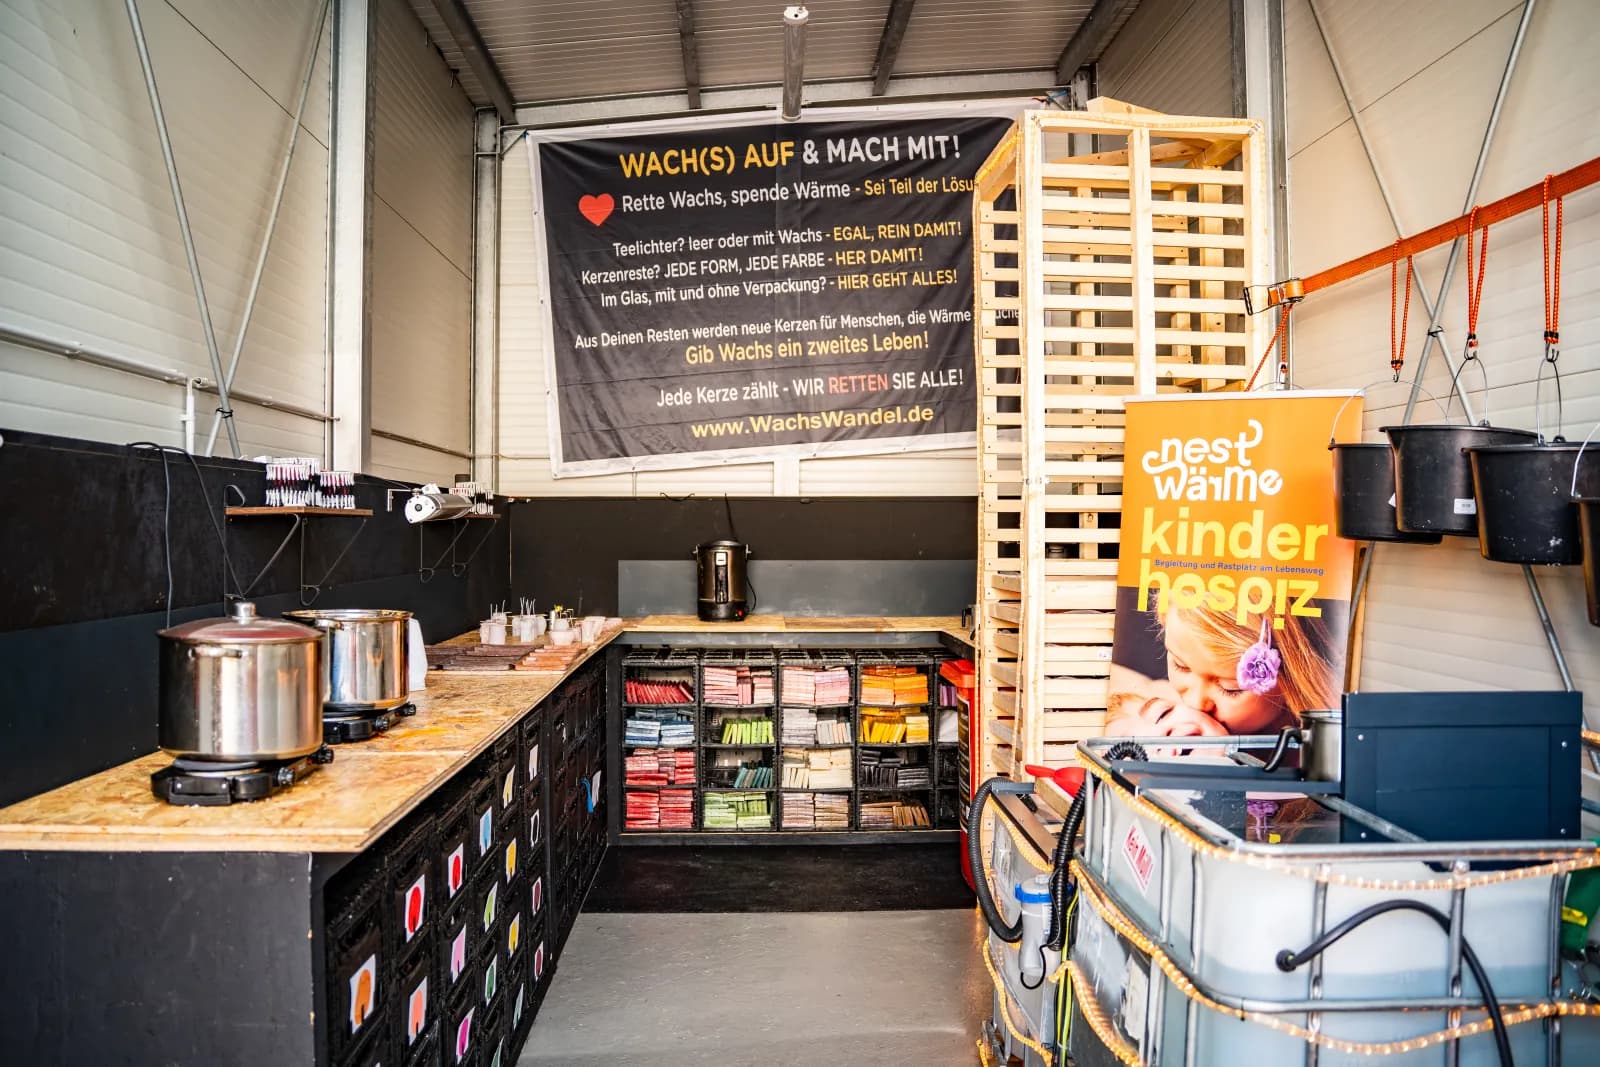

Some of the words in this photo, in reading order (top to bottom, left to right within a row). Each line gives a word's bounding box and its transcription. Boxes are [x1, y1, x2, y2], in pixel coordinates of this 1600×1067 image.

[620, 146, 735, 178] WACH(S)
[744, 142, 794, 168] AUF
[803, 140, 819, 164] &
[827, 137, 899, 163] MACH
[908, 135, 960, 160] MIT!
[623, 194, 664, 212] Rette
[670, 189, 726, 208] Wachs,
[732, 183, 789, 206] spende
[794, 182, 850, 199] Wärme
[865, 179, 885, 195] Sei
[889, 178, 912, 194] Teil
[916, 177, 938, 193] der
[942, 177, 973, 192] Lösu
[613, 238, 684, 256] Teelichter?
[689, 237, 714, 250] leer
[718, 233, 749, 248] oder
[753, 231, 774, 245] mit
[778, 228, 822, 243] Wachs
[834, 226, 874, 241] EGAL,
[878, 224, 910, 238] REIN
[914, 222, 961, 237] DAMIT!
[582, 265, 660, 284] Kerzenreste?
[664, 262, 697, 277] JEDE
[701, 258, 742, 274] FORM,
[746, 255, 779, 271] JEDE
[782, 253, 825, 268] FARBE
[836, 251, 866, 265] HER
[871, 248, 922, 263] DAMIT!
[601, 293, 617, 307] Im
[621, 290, 651, 306] Glas,
[656, 287, 676, 302] mit
[680, 285, 704, 300] und
[708, 283, 739, 298] ohne
[743, 276, 826, 296] Verpackung?
[838, 275, 869, 289] HIER
[873, 272, 907, 287] GEHT
[912, 269, 957, 285] ALLES!
[575, 335, 598, 348] Aus
[601, 332, 643, 347] Deinen
[647, 328, 688, 342] Resten
[692, 323, 737, 338] werden
[741, 323, 771, 335] neue
[775, 319, 817, 332] Kerzen
[820, 315, 837, 329] für
[841, 312, 904, 328] Menschen,
[908, 311, 926, 324] die
[929, 309, 970, 323] Wärme
[686, 345, 714, 364] Gib
[719, 341, 773, 361] Wachs
[778, 338, 802, 357] ein
[807, 335, 868, 355] zweites
[873, 331, 928, 351] Leben!
[657, 388, 692, 407] Jede
[697, 387, 738, 403] Kerze
[743, 381, 779, 400] zählt
[793, 378, 824, 396] WIR
[829, 374, 888, 393] RETTEN
[893, 372, 916, 389] SIE
[920, 369, 963, 387] ALLE!
[691, 405, 933, 437] www.WachsWandel.de
[1142, 419, 1263, 467] nest
[1153, 466, 1283, 501] wärme
[1140, 507, 1328, 560] kinder
[1154, 560, 1198, 570] Begleitung
[1218, 562, 1256, 572] Rastplatz
[1276, 565, 1324, 576] Lebensweg
